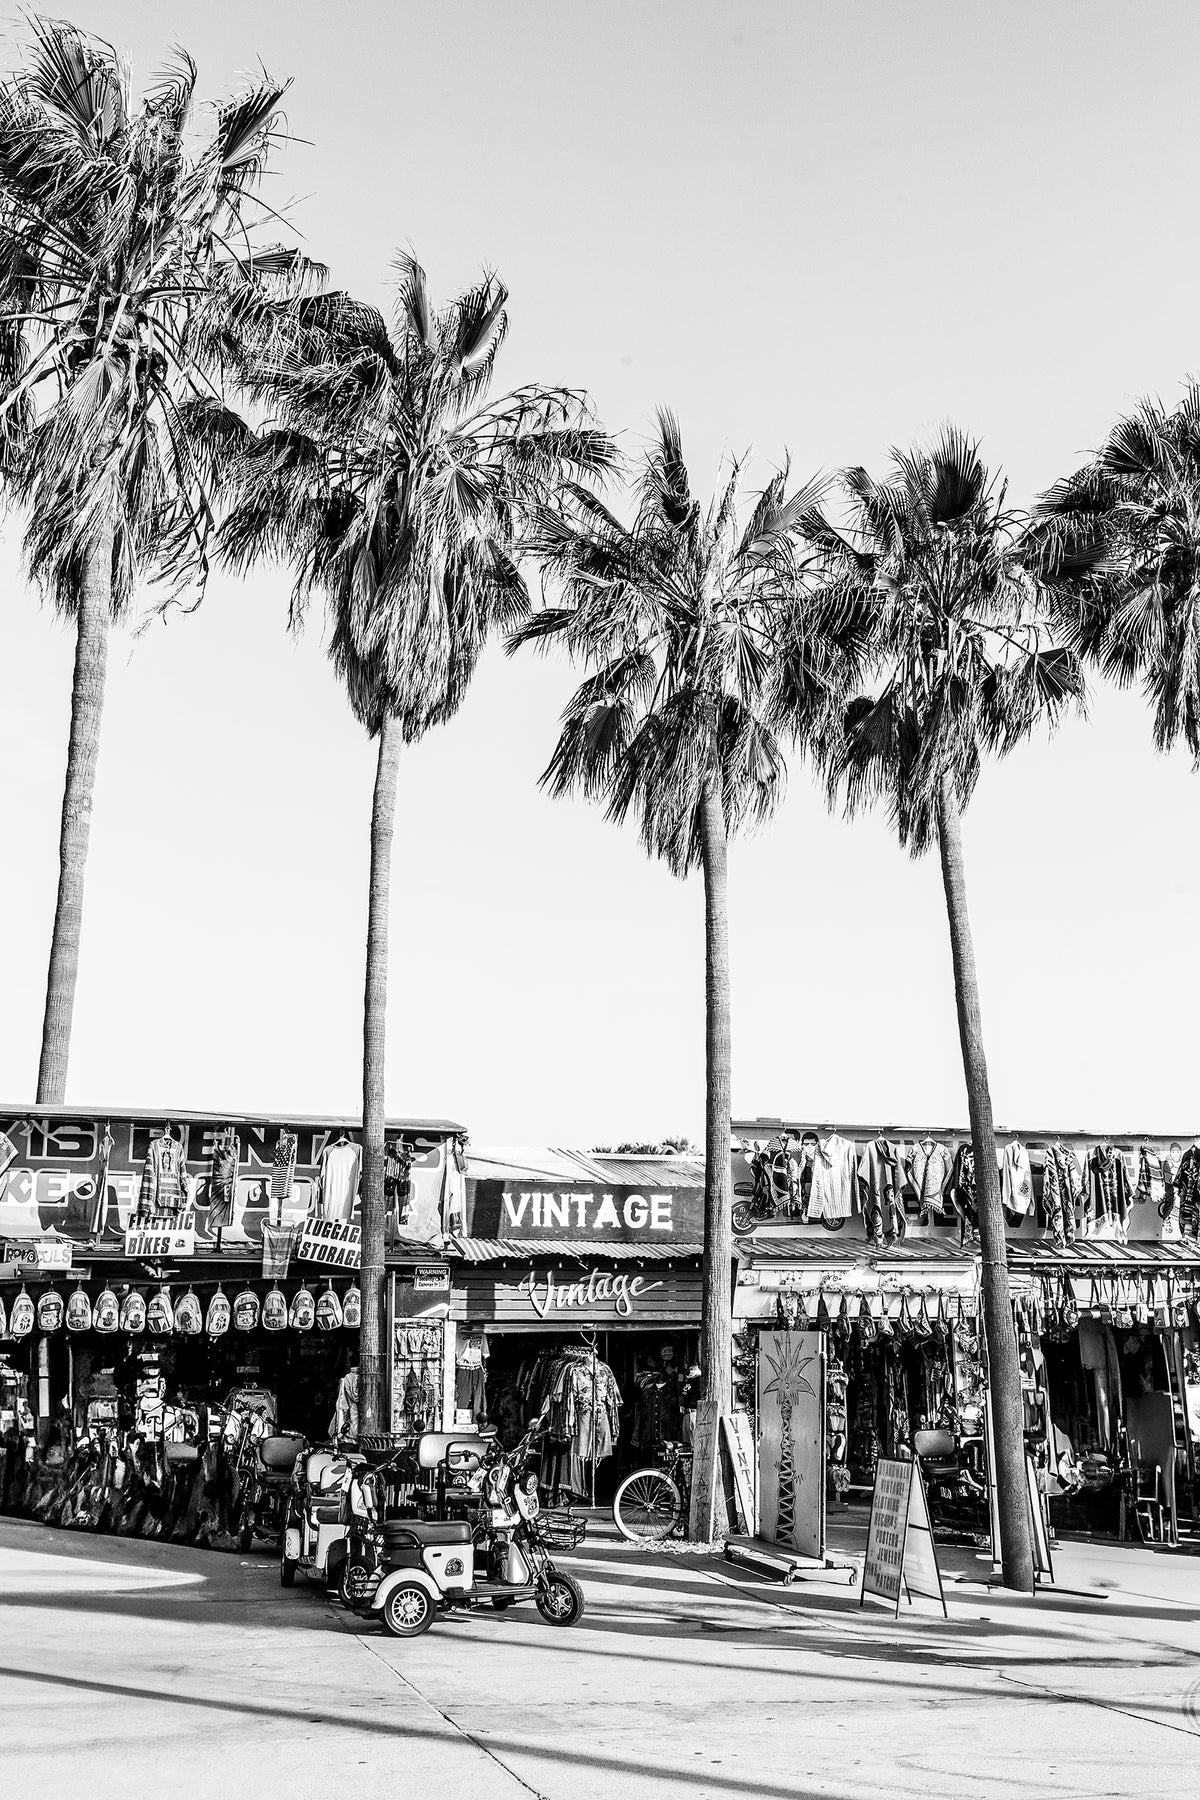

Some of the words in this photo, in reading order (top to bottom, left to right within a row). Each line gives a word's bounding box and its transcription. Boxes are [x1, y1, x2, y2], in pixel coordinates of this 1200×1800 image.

[502, 1193, 673, 1231] VINTAGE
[304, 1218, 361, 1245] LUGGAG
[127, 1237, 171, 1255] BIKES
[517, 1267, 664, 1318] Vintage
[874, 1494, 900, 1513] CLOTHING
[874, 1512, 898, 1530] RECORDS
[875, 1529, 899, 1548] POSTERS
[877, 1546, 901, 1566] JEWELRY
[875, 1573, 899, 1593] PATCHES
